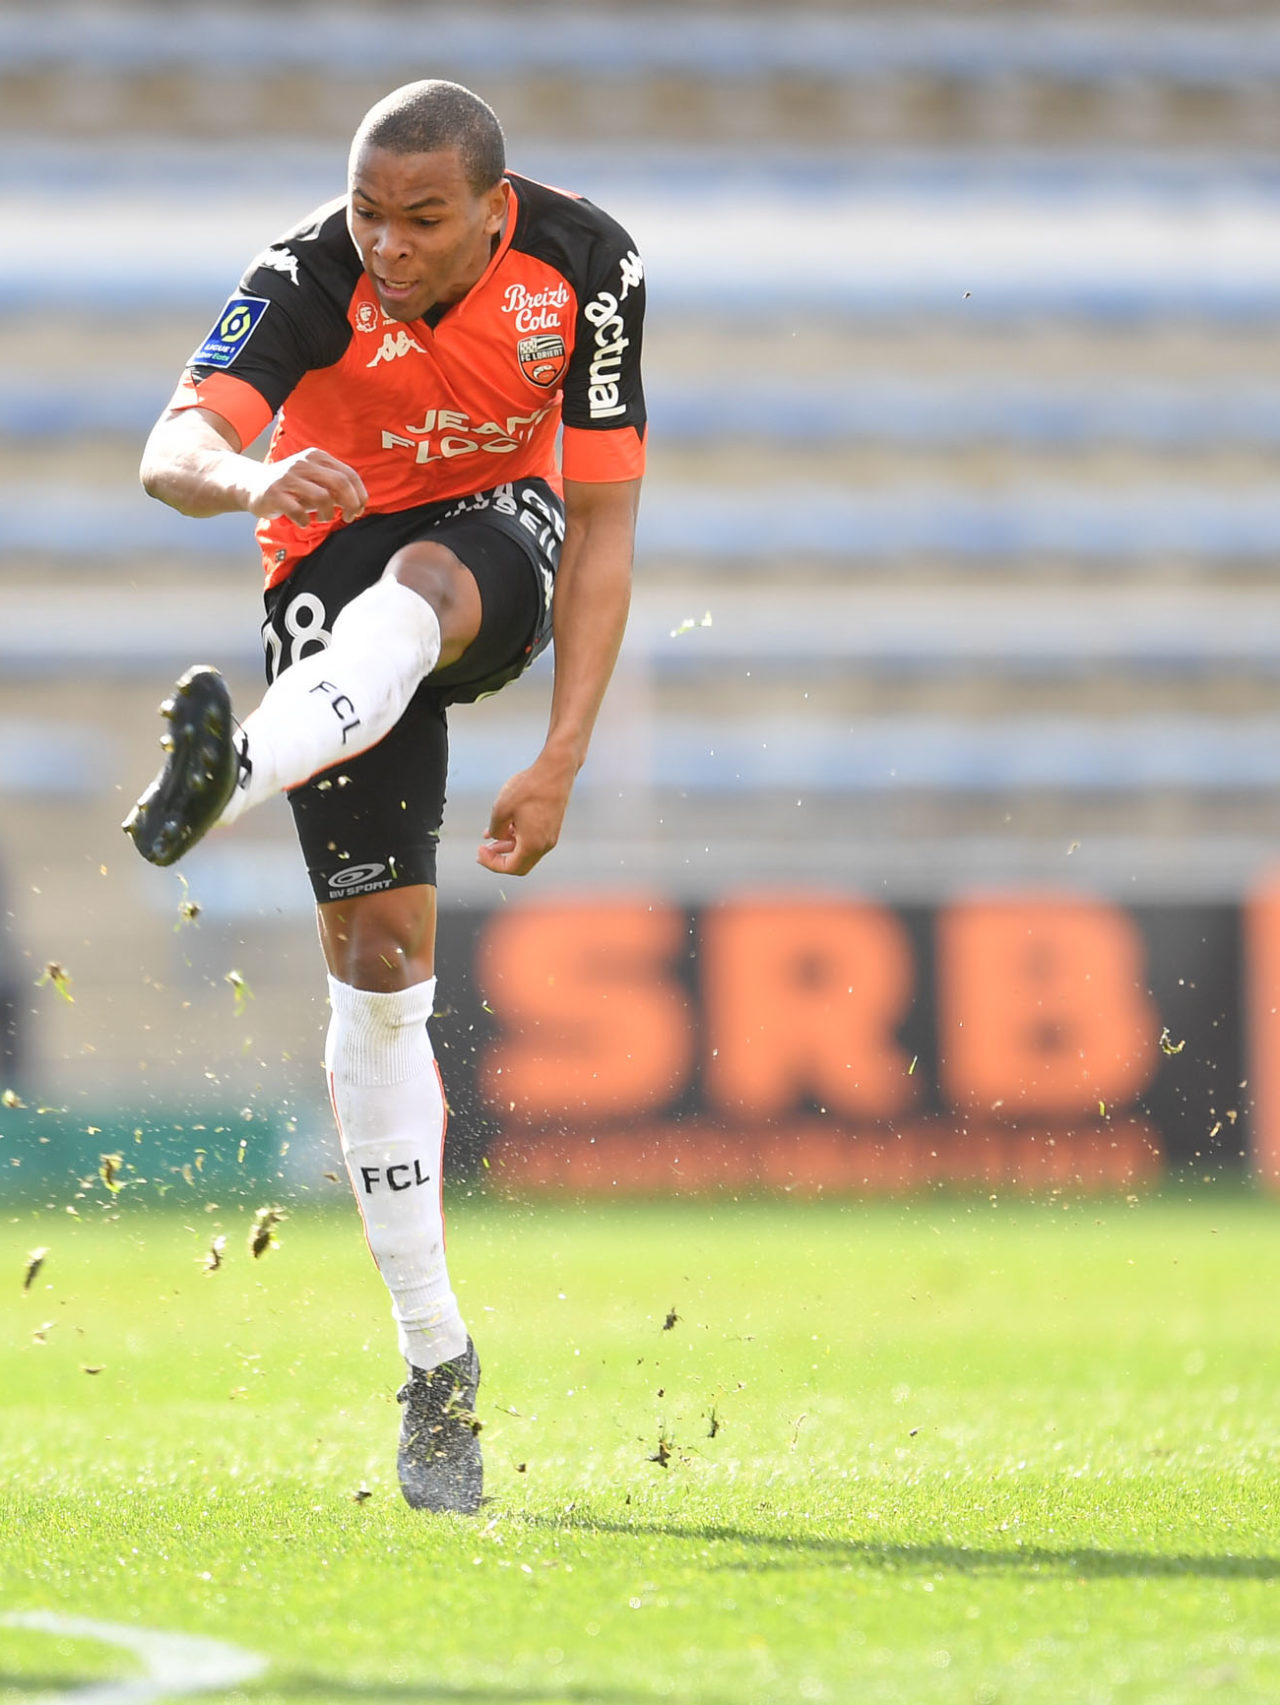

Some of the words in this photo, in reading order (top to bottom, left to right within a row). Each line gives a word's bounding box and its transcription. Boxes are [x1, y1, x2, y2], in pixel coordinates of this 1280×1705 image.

[501, 282, 569, 312] Breizh
[515, 308, 561, 333] Cola
[521, 354, 532, 362] FC
[532, 348, 564, 360] LORIENT
[584, 291, 630, 419] actual
[309, 680, 360, 745] FCL
[329, 889, 345, 898] BV
[346, 879, 393, 896] SPORT
[360, 1159, 430, 1194] FCL
